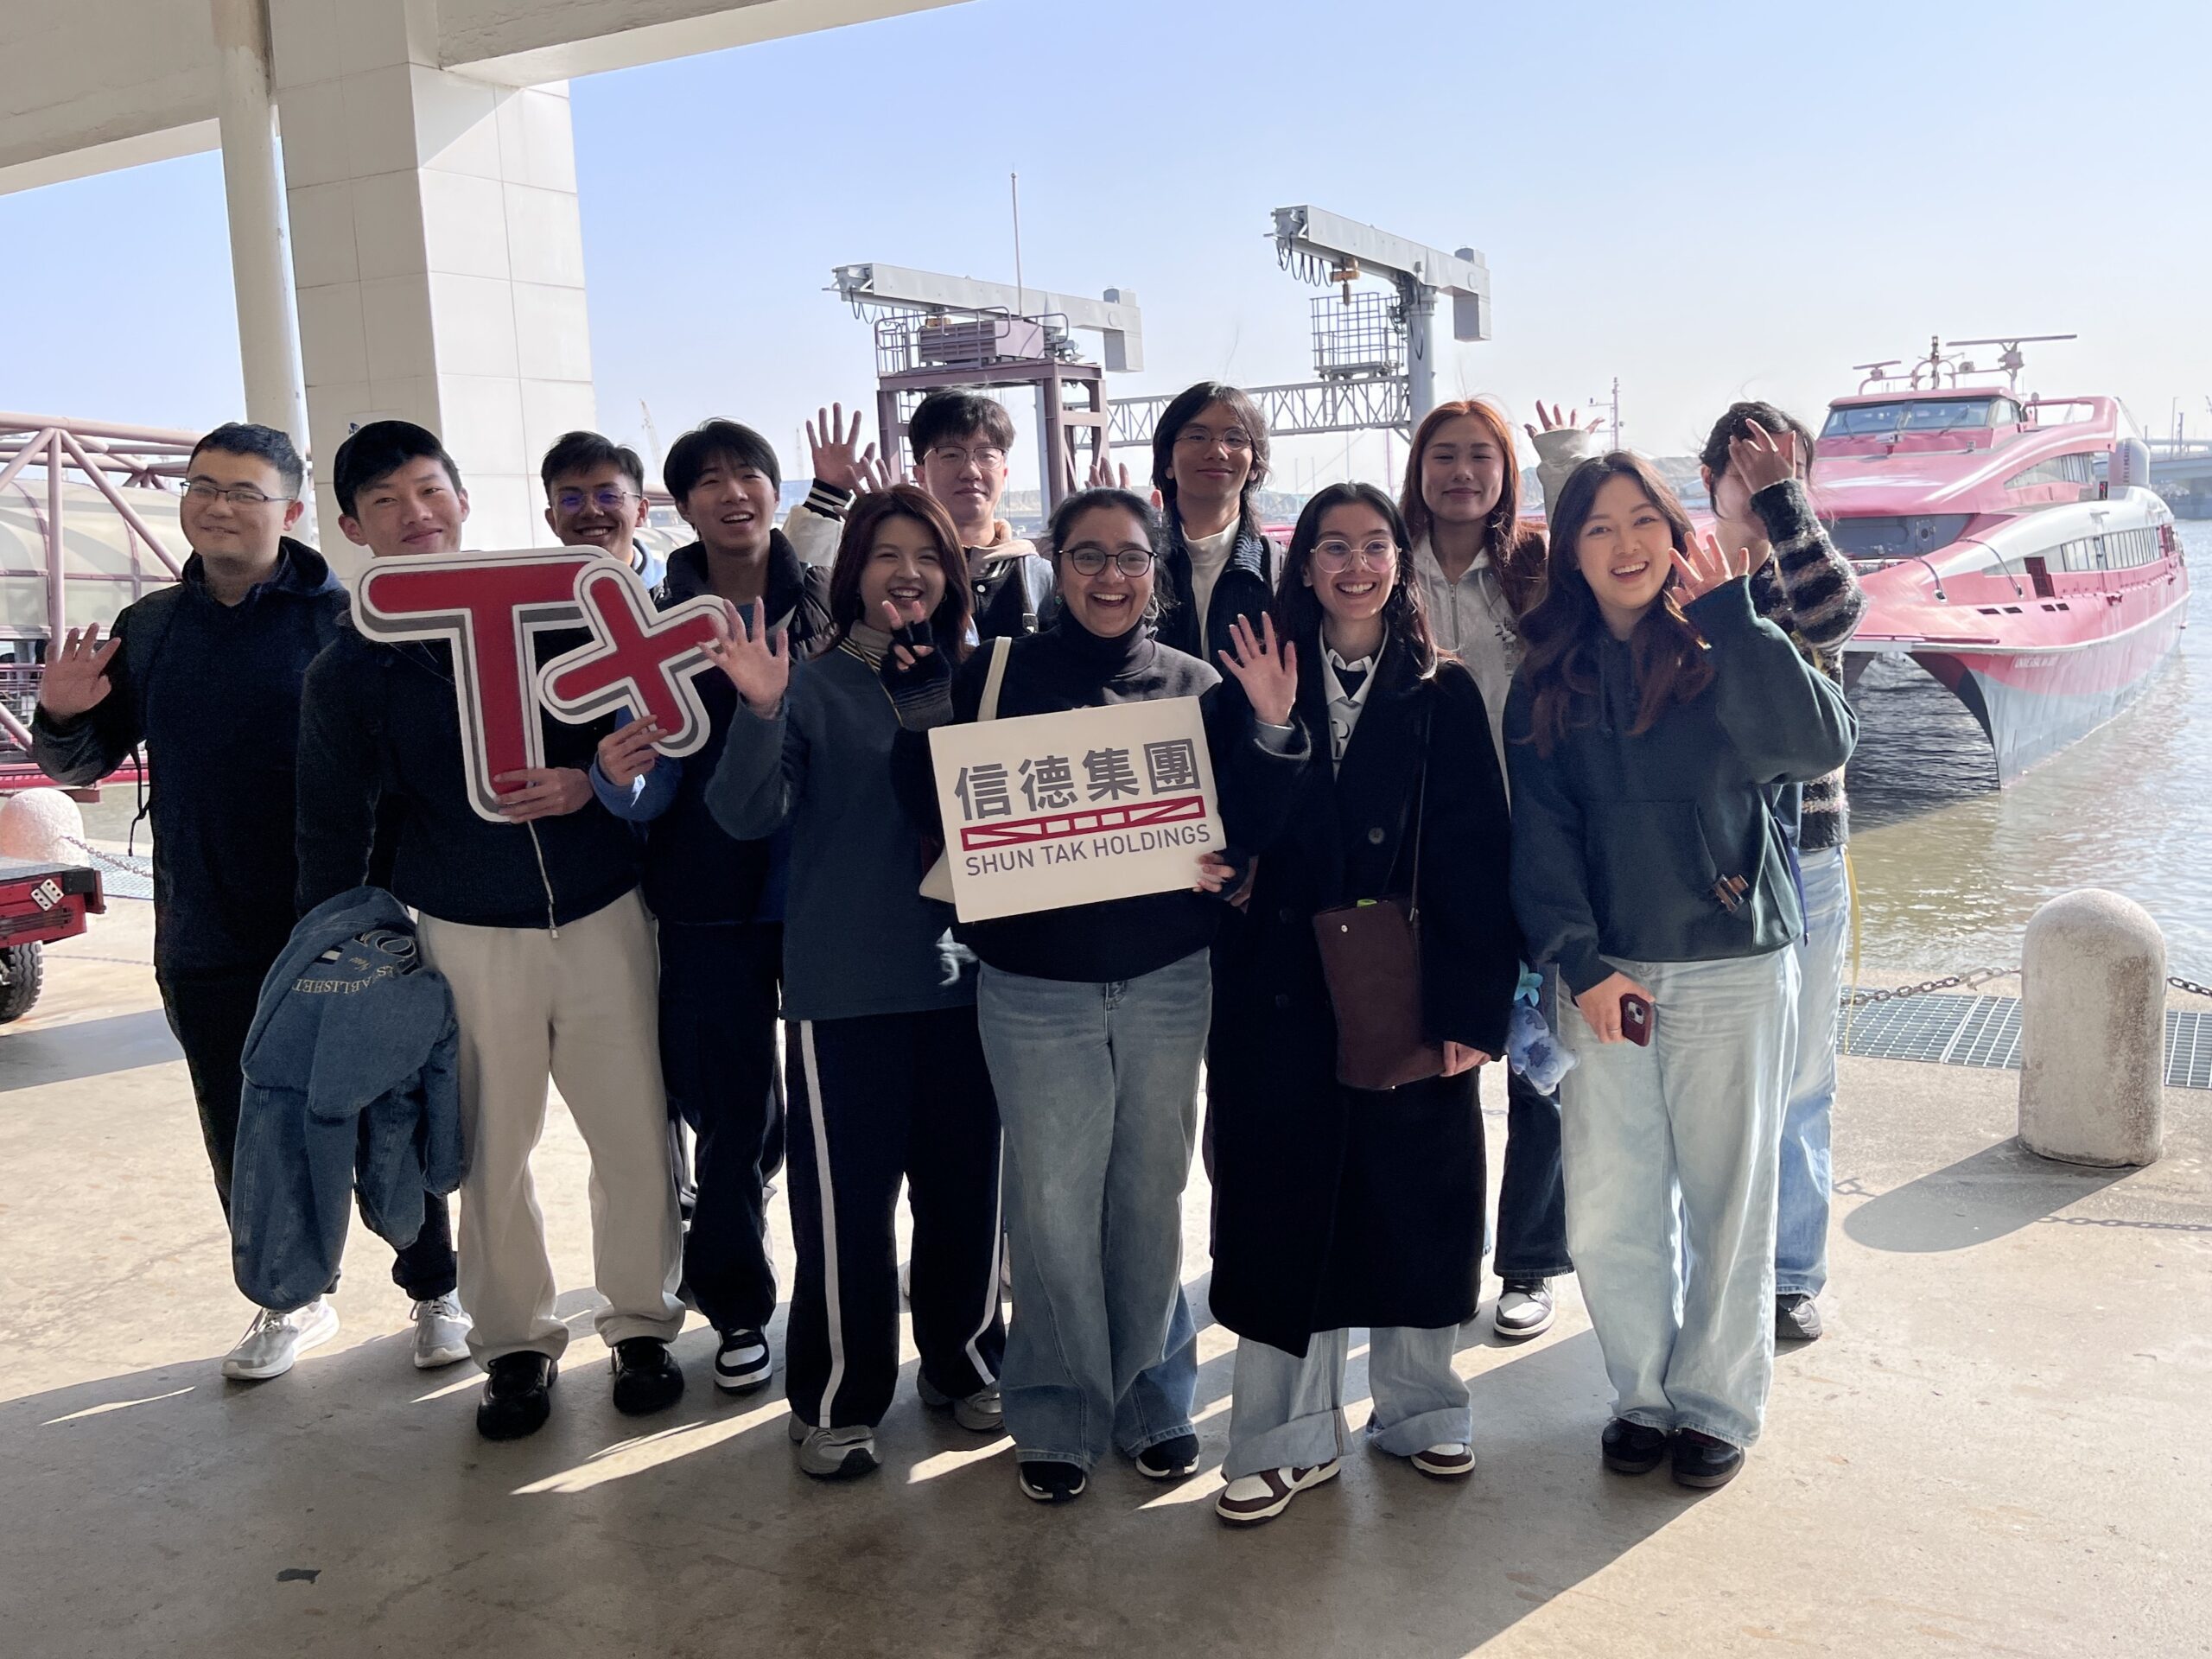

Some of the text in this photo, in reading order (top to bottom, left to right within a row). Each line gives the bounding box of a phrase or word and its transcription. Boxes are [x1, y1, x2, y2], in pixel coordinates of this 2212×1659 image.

[954, 738, 1202, 822] 信德集團
[966, 824, 1211, 877] SHUN TAK HOLDINGS
